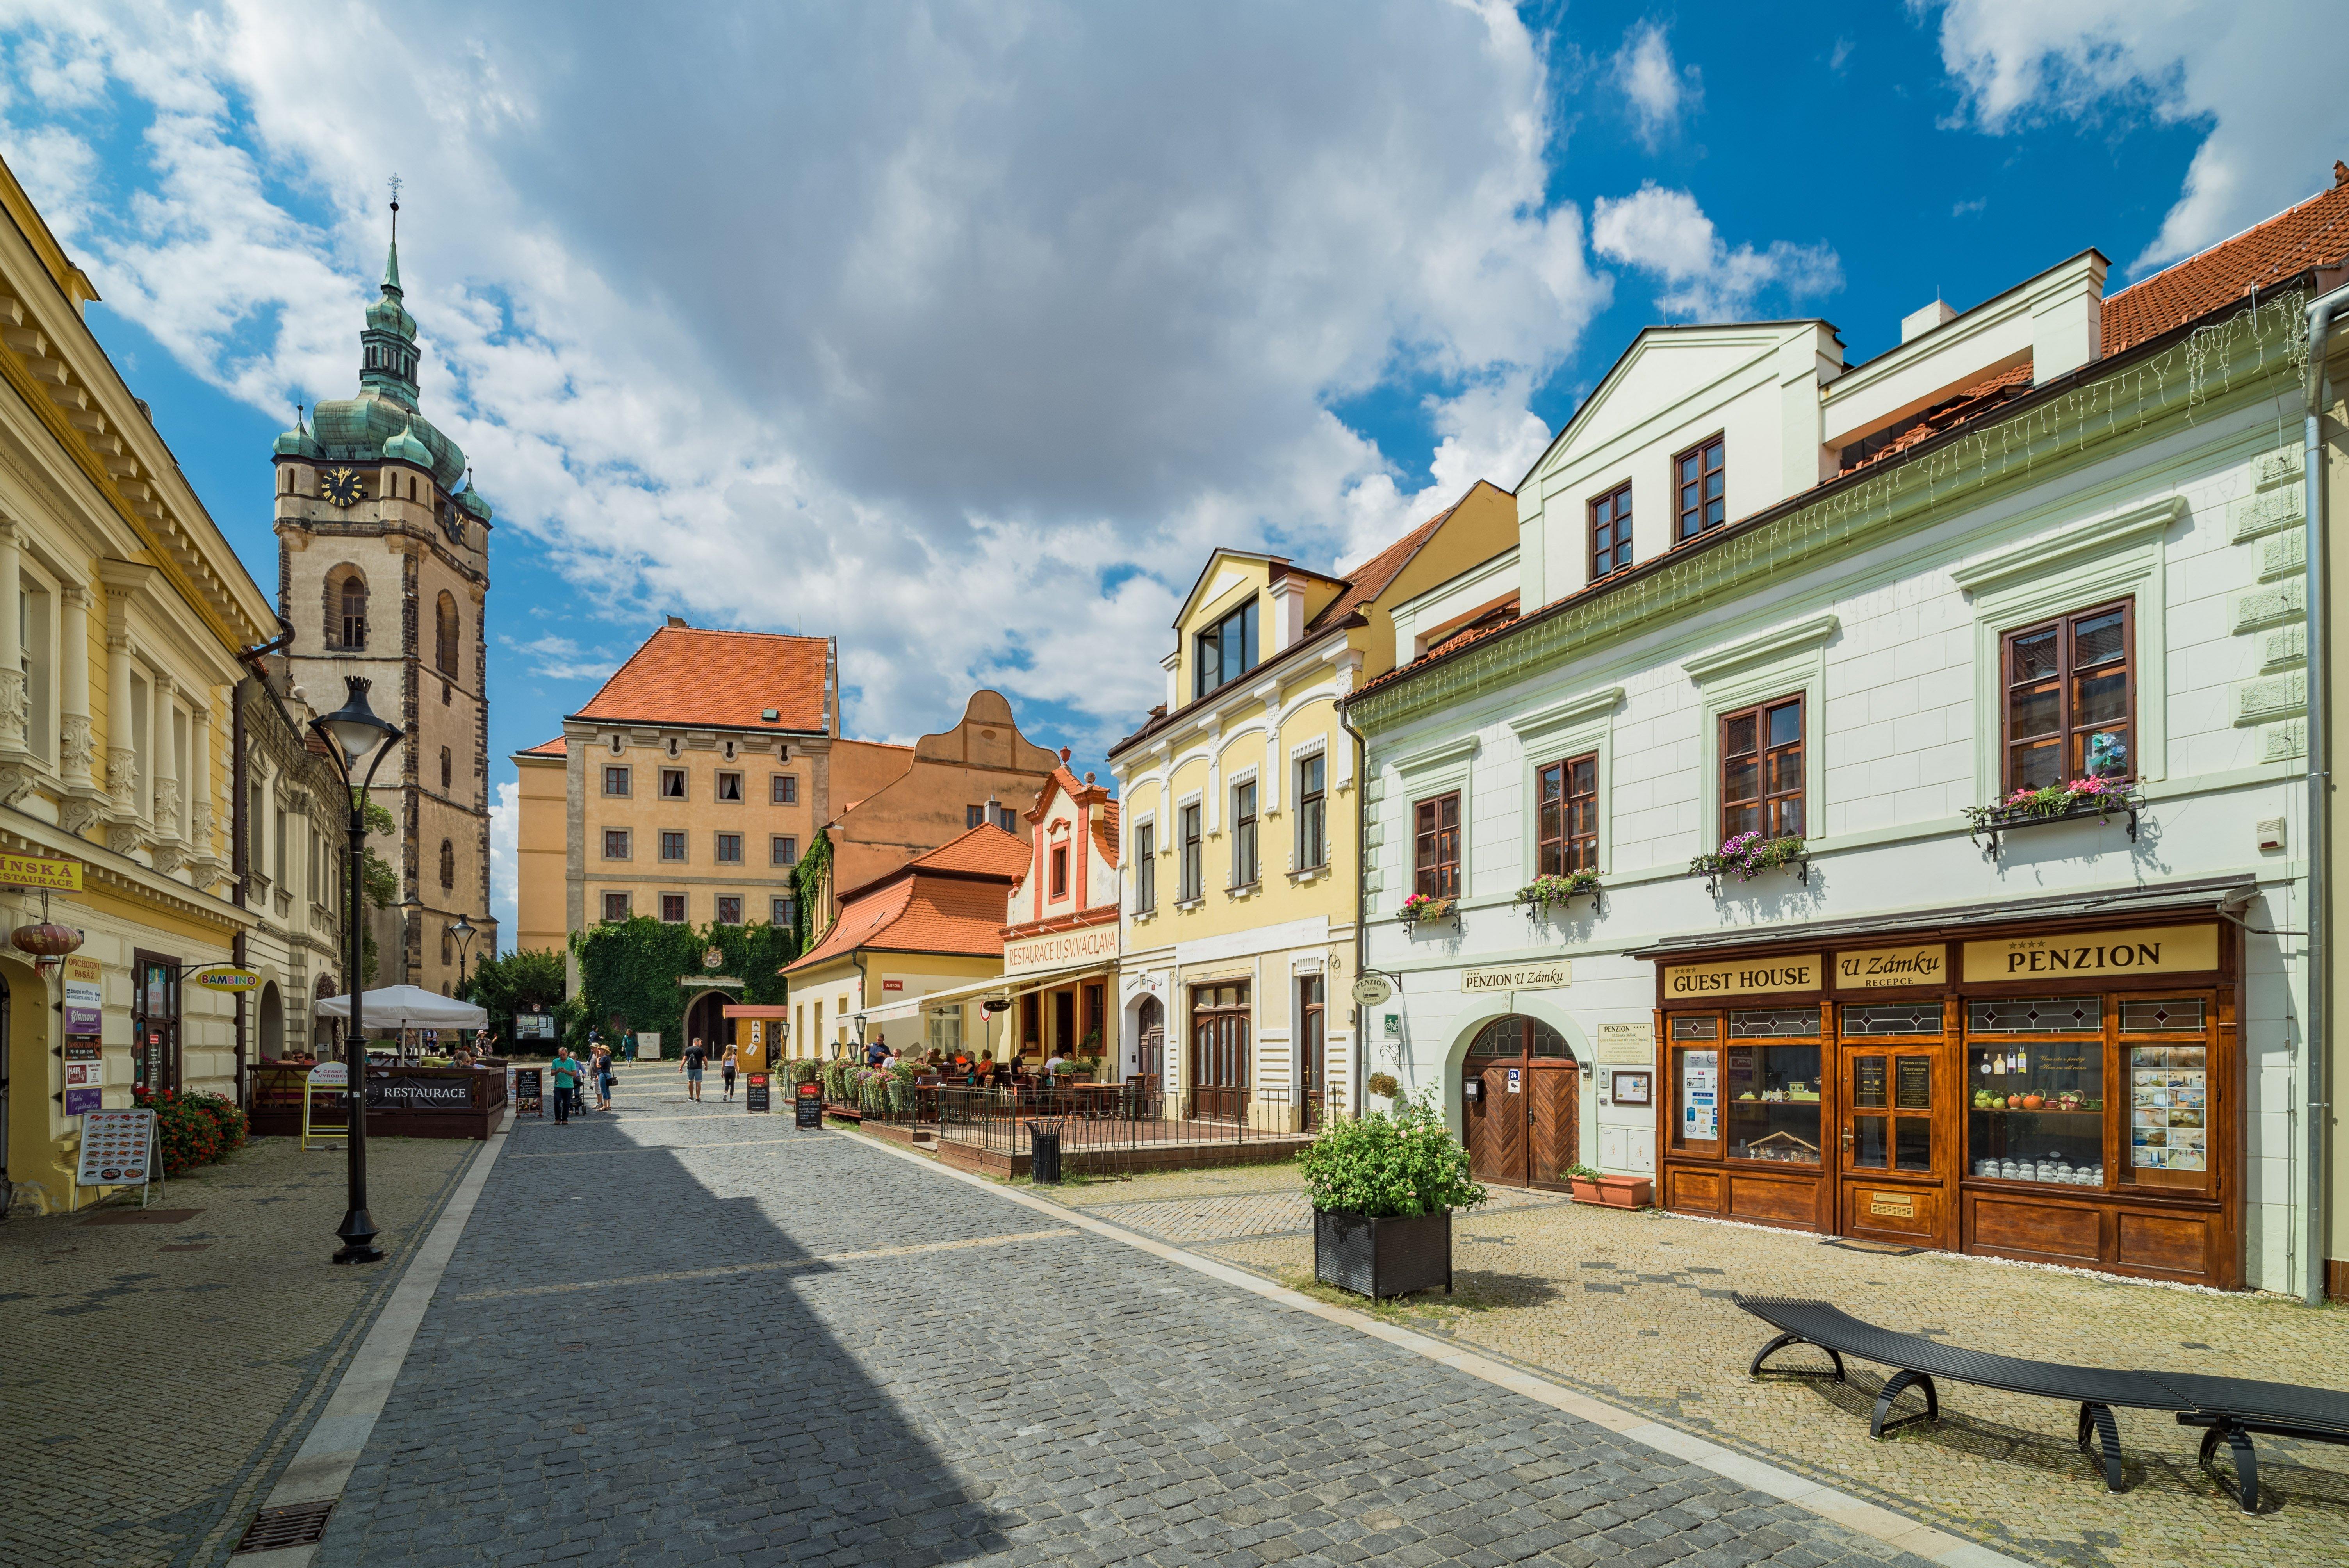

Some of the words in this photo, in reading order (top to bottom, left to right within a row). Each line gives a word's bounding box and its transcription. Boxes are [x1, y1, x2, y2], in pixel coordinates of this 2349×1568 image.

[0, 873, 73, 887] STAURACE
[1009, 942, 1054, 966] RESTAURACE
[1057, 941, 1062, 959] U
[2008, 943, 2161, 972] PENZION
[1841, 959, 1860, 976] U
[1866, 951, 1940, 975] Zámku
[201, 975, 256, 985] BAMBINO
[1356, 979, 1387, 990] PENZION
[1467, 974, 1511, 988] PENZION
[1515, 973, 1524, 984] U
[1527, 969, 1564, 984] Zámku
[1674, 973, 1732, 992] GUEST
[1739, 967, 1810, 987] HOUSE
[1866, 978, 1913, 986] RECEPCE
[68, 1067, 80, 1079] HAIR
[385, 1088, 465, 1098] RESTAURACE
